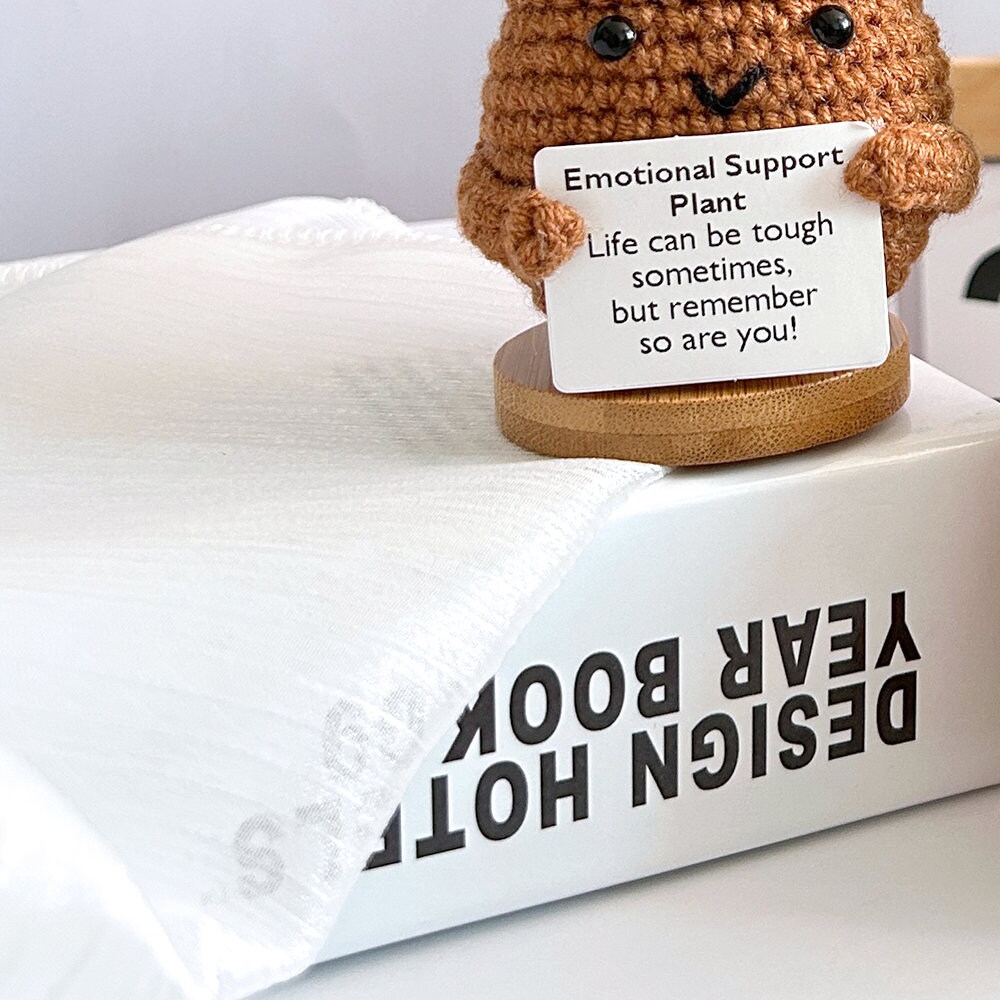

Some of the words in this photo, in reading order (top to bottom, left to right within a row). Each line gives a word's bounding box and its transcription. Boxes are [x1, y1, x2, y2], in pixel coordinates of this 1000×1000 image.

[564, 155, 716, 192] Emotional
[725, 146, 844, 182] Support
[670, 191, 747, 217] Plant
[587, 230, 639, 259] Life
[648, 232, 696, 253] can
[707, 222, 741, 248] be
[753, 210, 834, 247] tough
[632, 256, 793, 289] sometimes,
[611, 299, 661, 324] but
[669, 285, 819, 320] remember
[639, 335, 672, 355] so
[682, 330, 727, 351] are
[736, 315, 798, 353] you!
[716, 589, 923, 701] YEAR
[441, 637, 681, 765] BOOK
[631, 669, 919, 809] DESIGN
